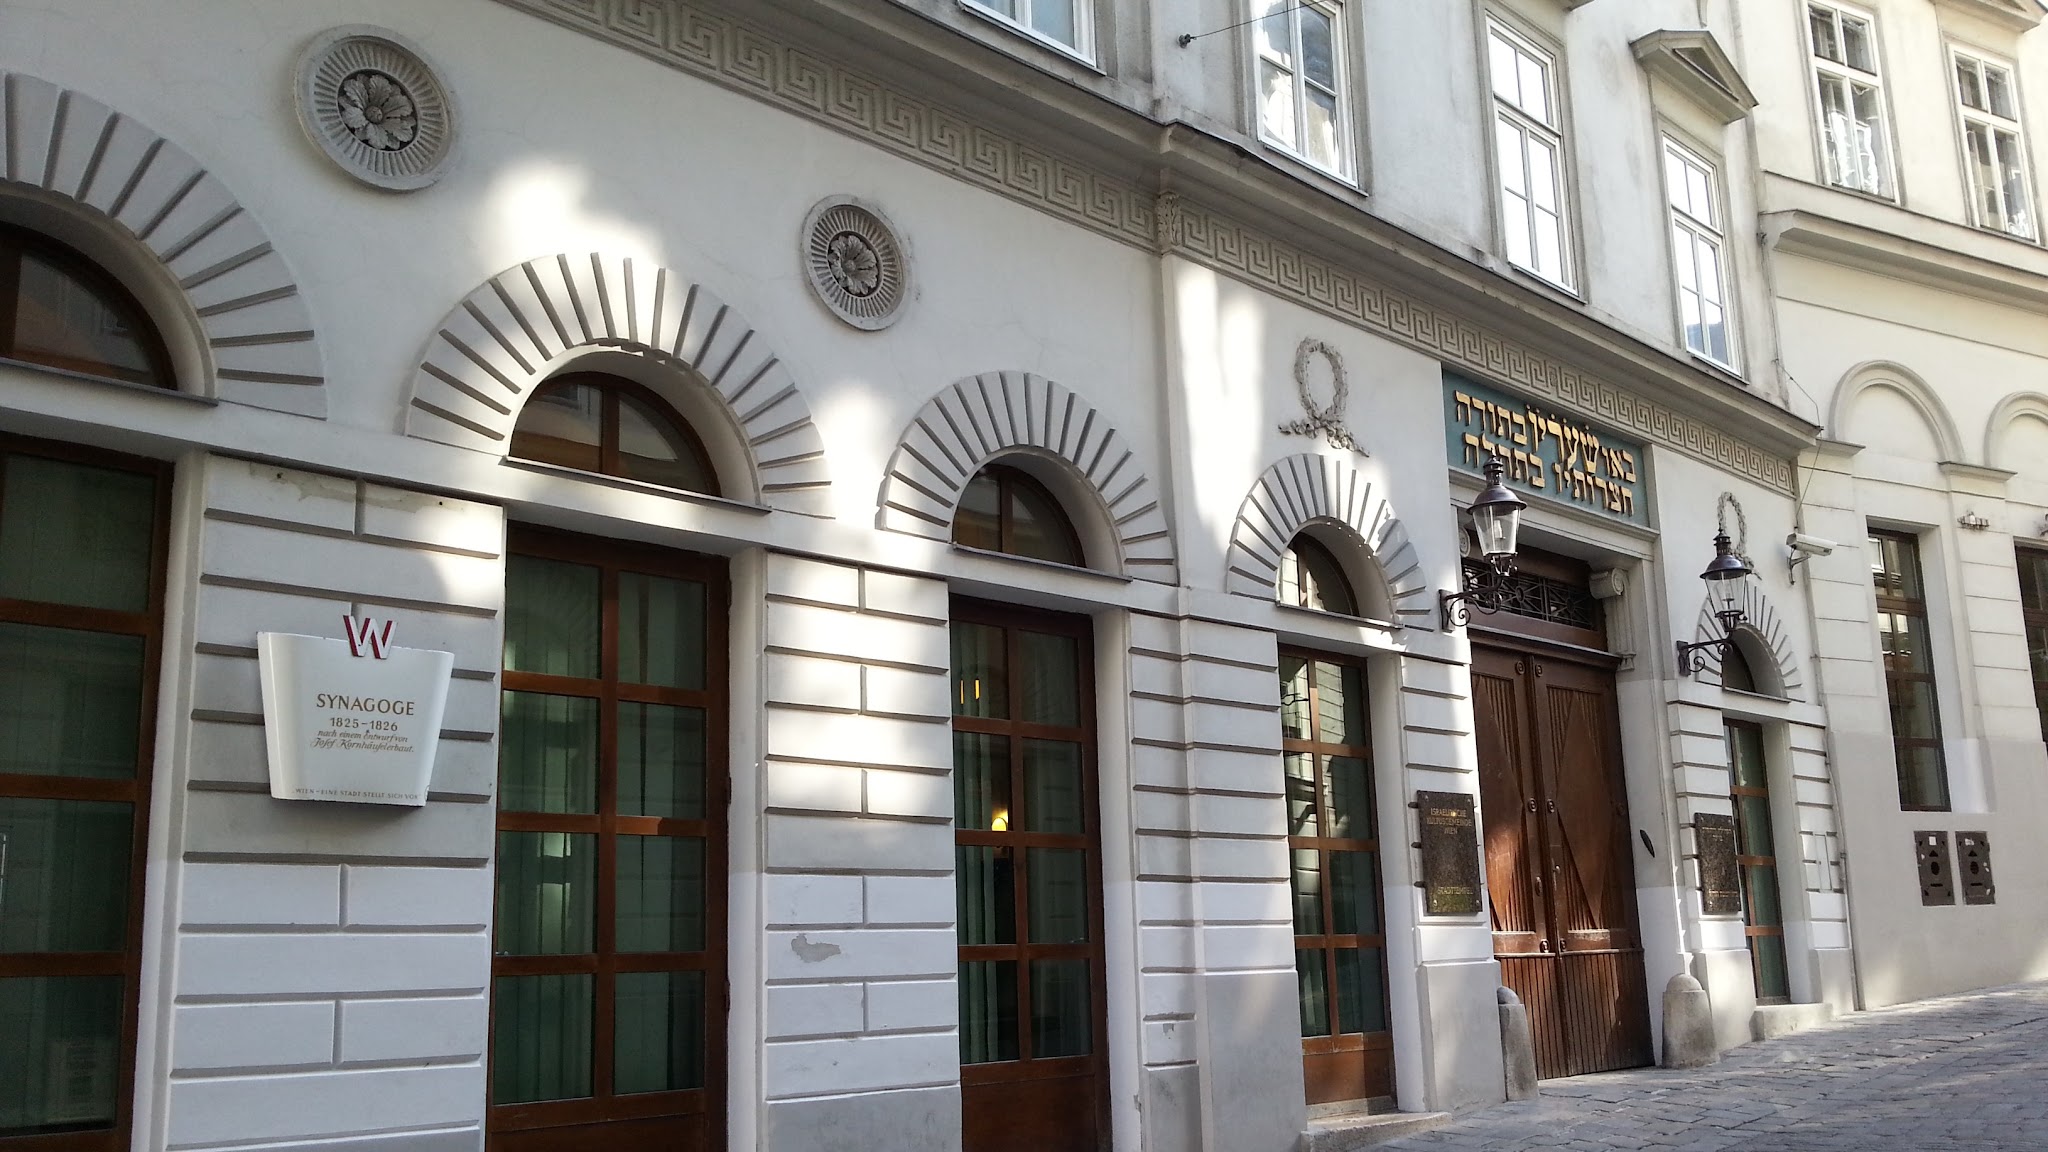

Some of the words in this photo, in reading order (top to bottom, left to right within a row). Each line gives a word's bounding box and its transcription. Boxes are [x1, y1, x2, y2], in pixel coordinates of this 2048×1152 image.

[1455, 390, 1528, 446] בתודה
[1600, 445, 1637, 483] באו
[343, 614, 398, 660] W
[316, 693, 415, 716] SYNAGOGE
[318, 730, 337, 738] nach
[339, 731, 362, 740] einem
[363, 731, 394, 743] Entwurf
